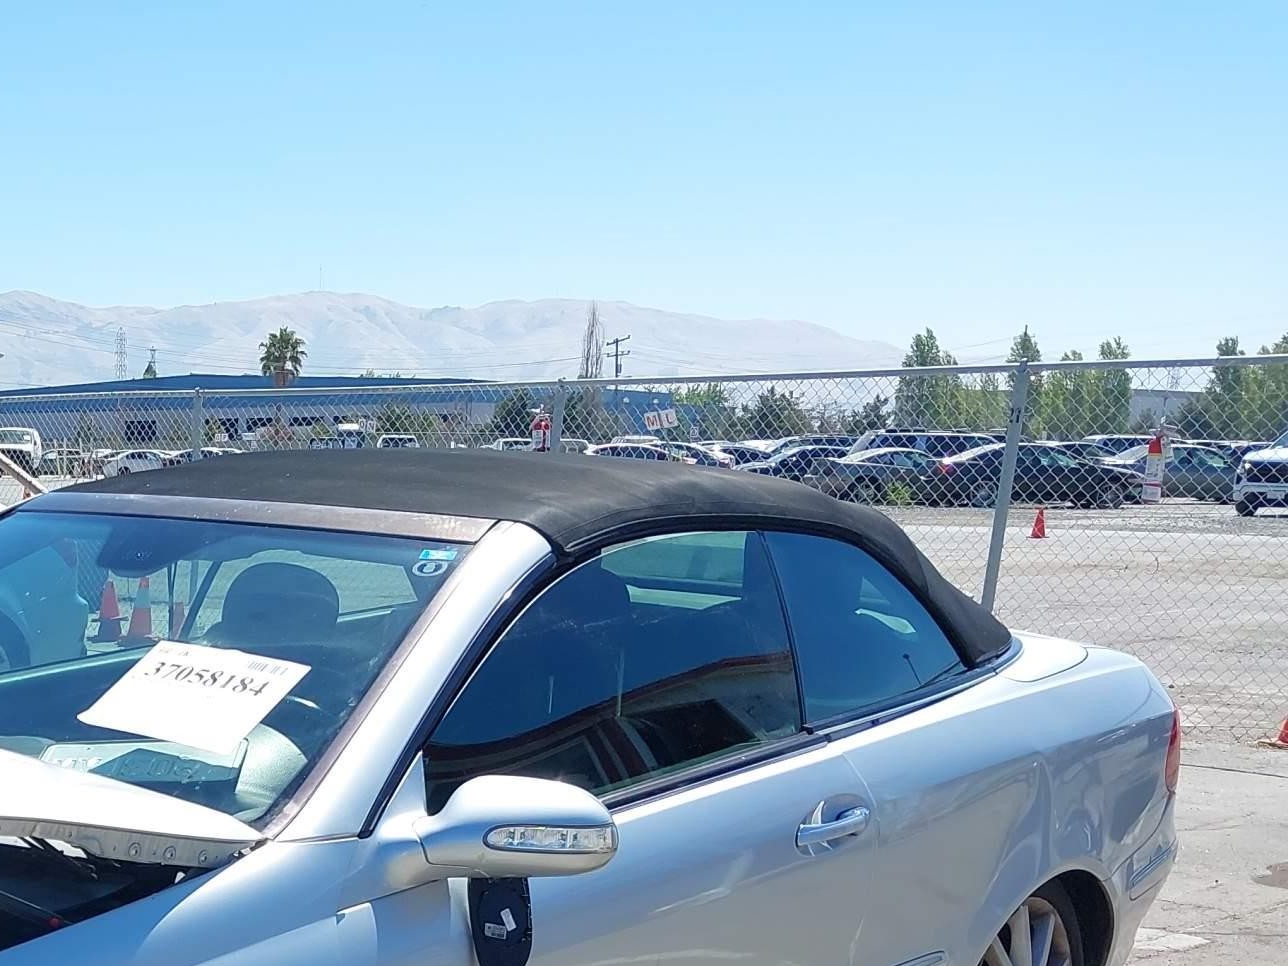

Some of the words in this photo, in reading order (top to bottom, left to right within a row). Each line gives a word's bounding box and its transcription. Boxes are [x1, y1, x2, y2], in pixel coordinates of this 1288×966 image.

[646, 415, 658, 428] M
[665, 413, 673, 425] L
[144, 661, 270, 697] 37058184
